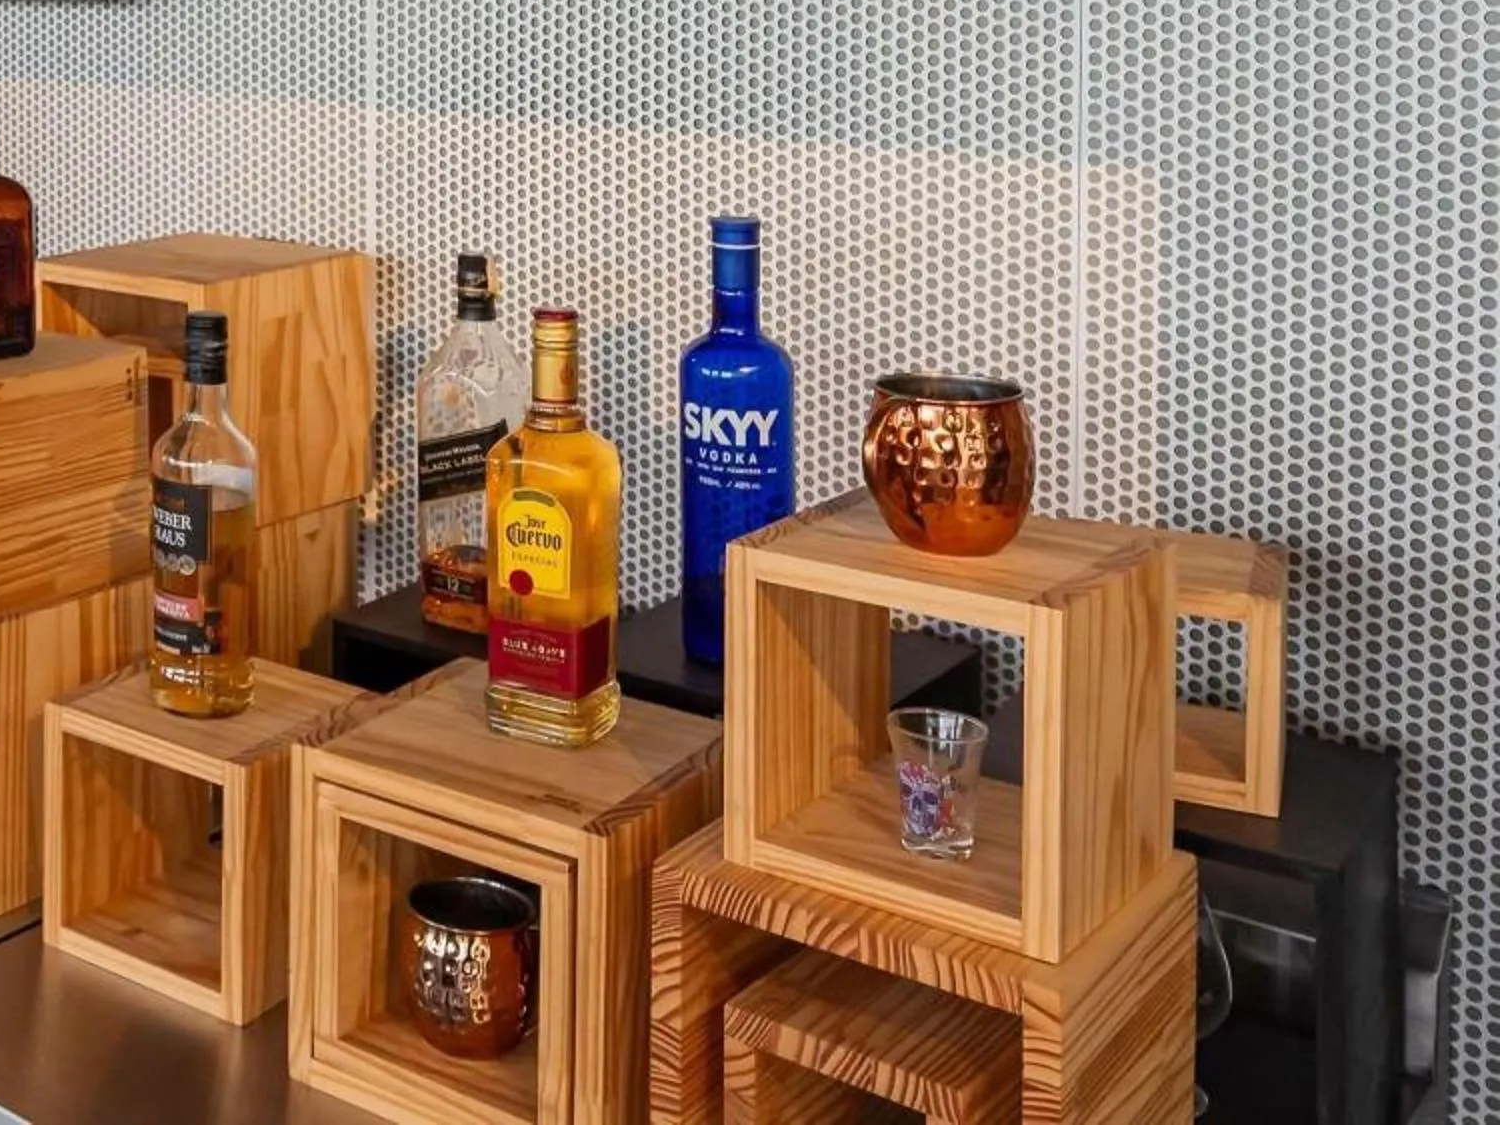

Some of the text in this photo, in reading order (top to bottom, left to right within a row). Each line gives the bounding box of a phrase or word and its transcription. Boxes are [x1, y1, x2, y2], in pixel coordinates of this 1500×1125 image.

[684, 402, 779, 447] SKYY
[699, 447, 758, 465] VODKA
[506, 521, 563, 552] Cuervo
